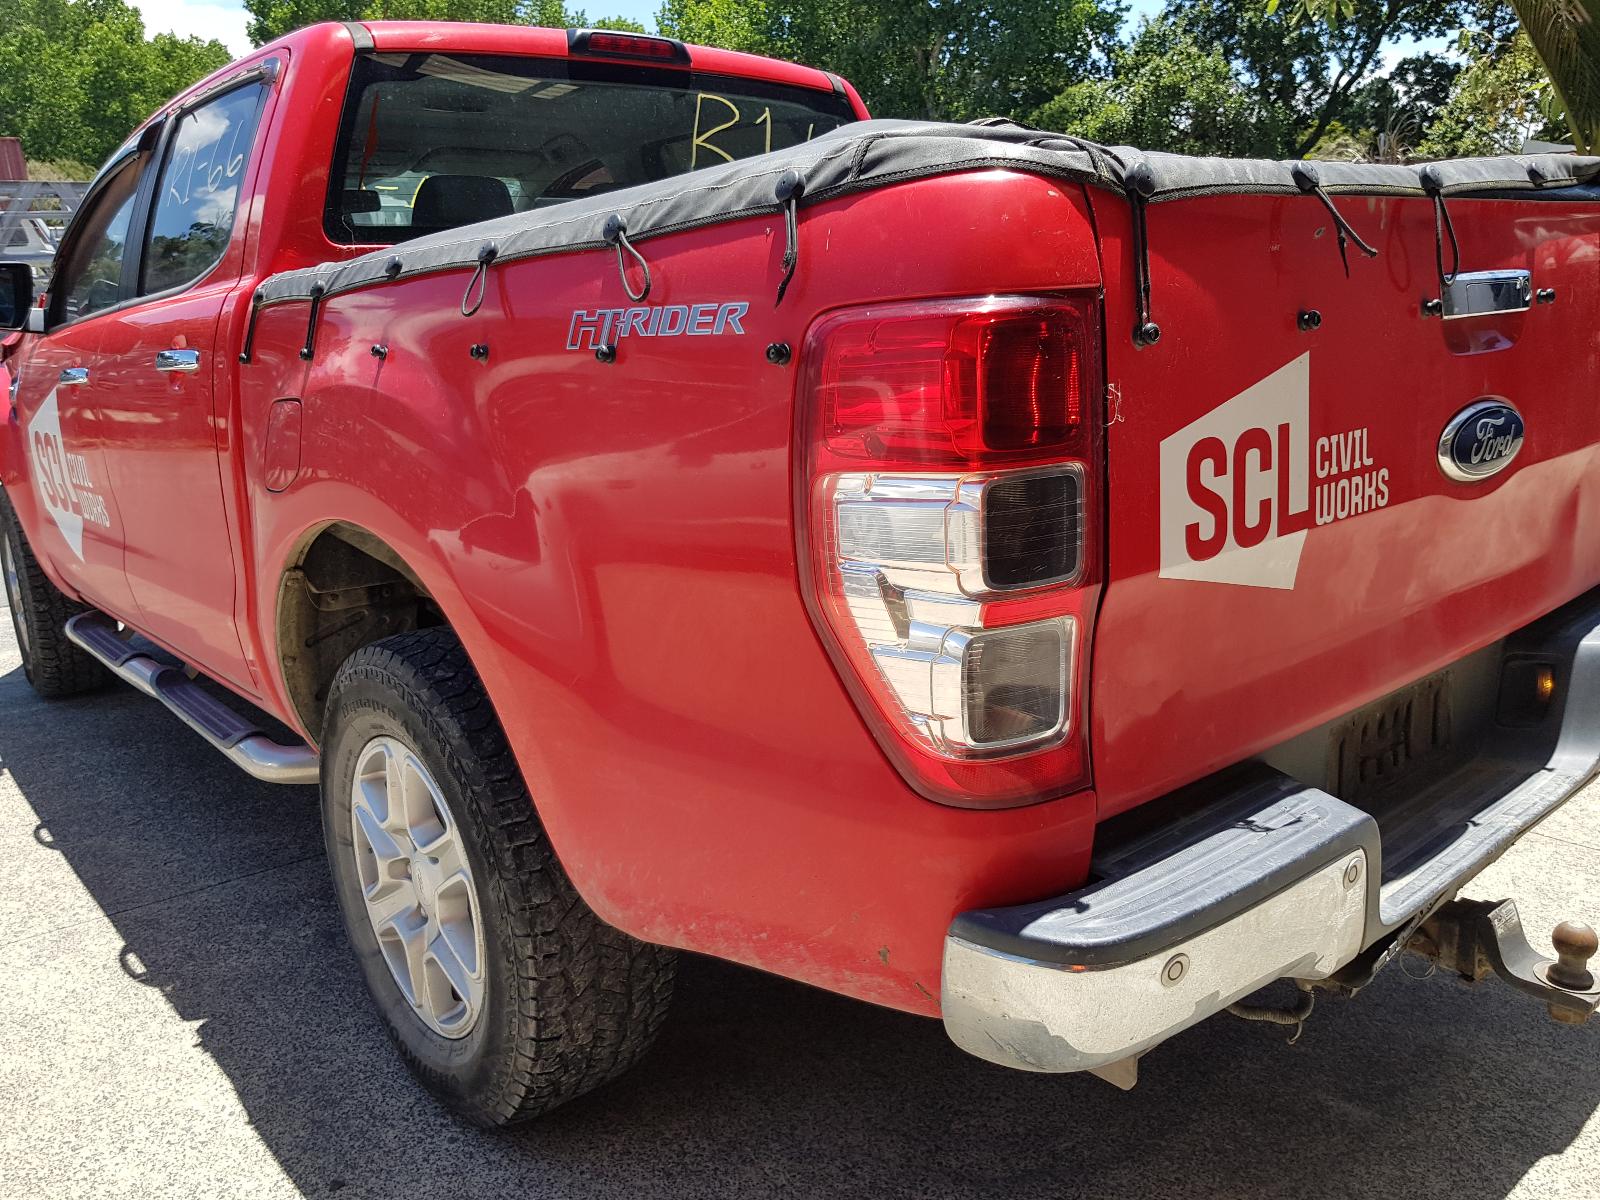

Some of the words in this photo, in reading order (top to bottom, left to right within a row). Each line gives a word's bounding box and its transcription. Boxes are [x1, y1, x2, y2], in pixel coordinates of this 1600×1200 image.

[1315, 428, 1374, 478] CIVIL
[1470, 416, 1515, 464] Ford
[34, 430, 83, 517] SCL
[66, 452, 94, 488] CIVIL
[1184, 422, 1309, 561] SCL
[1315, 468, 1389, 525] WORKS
